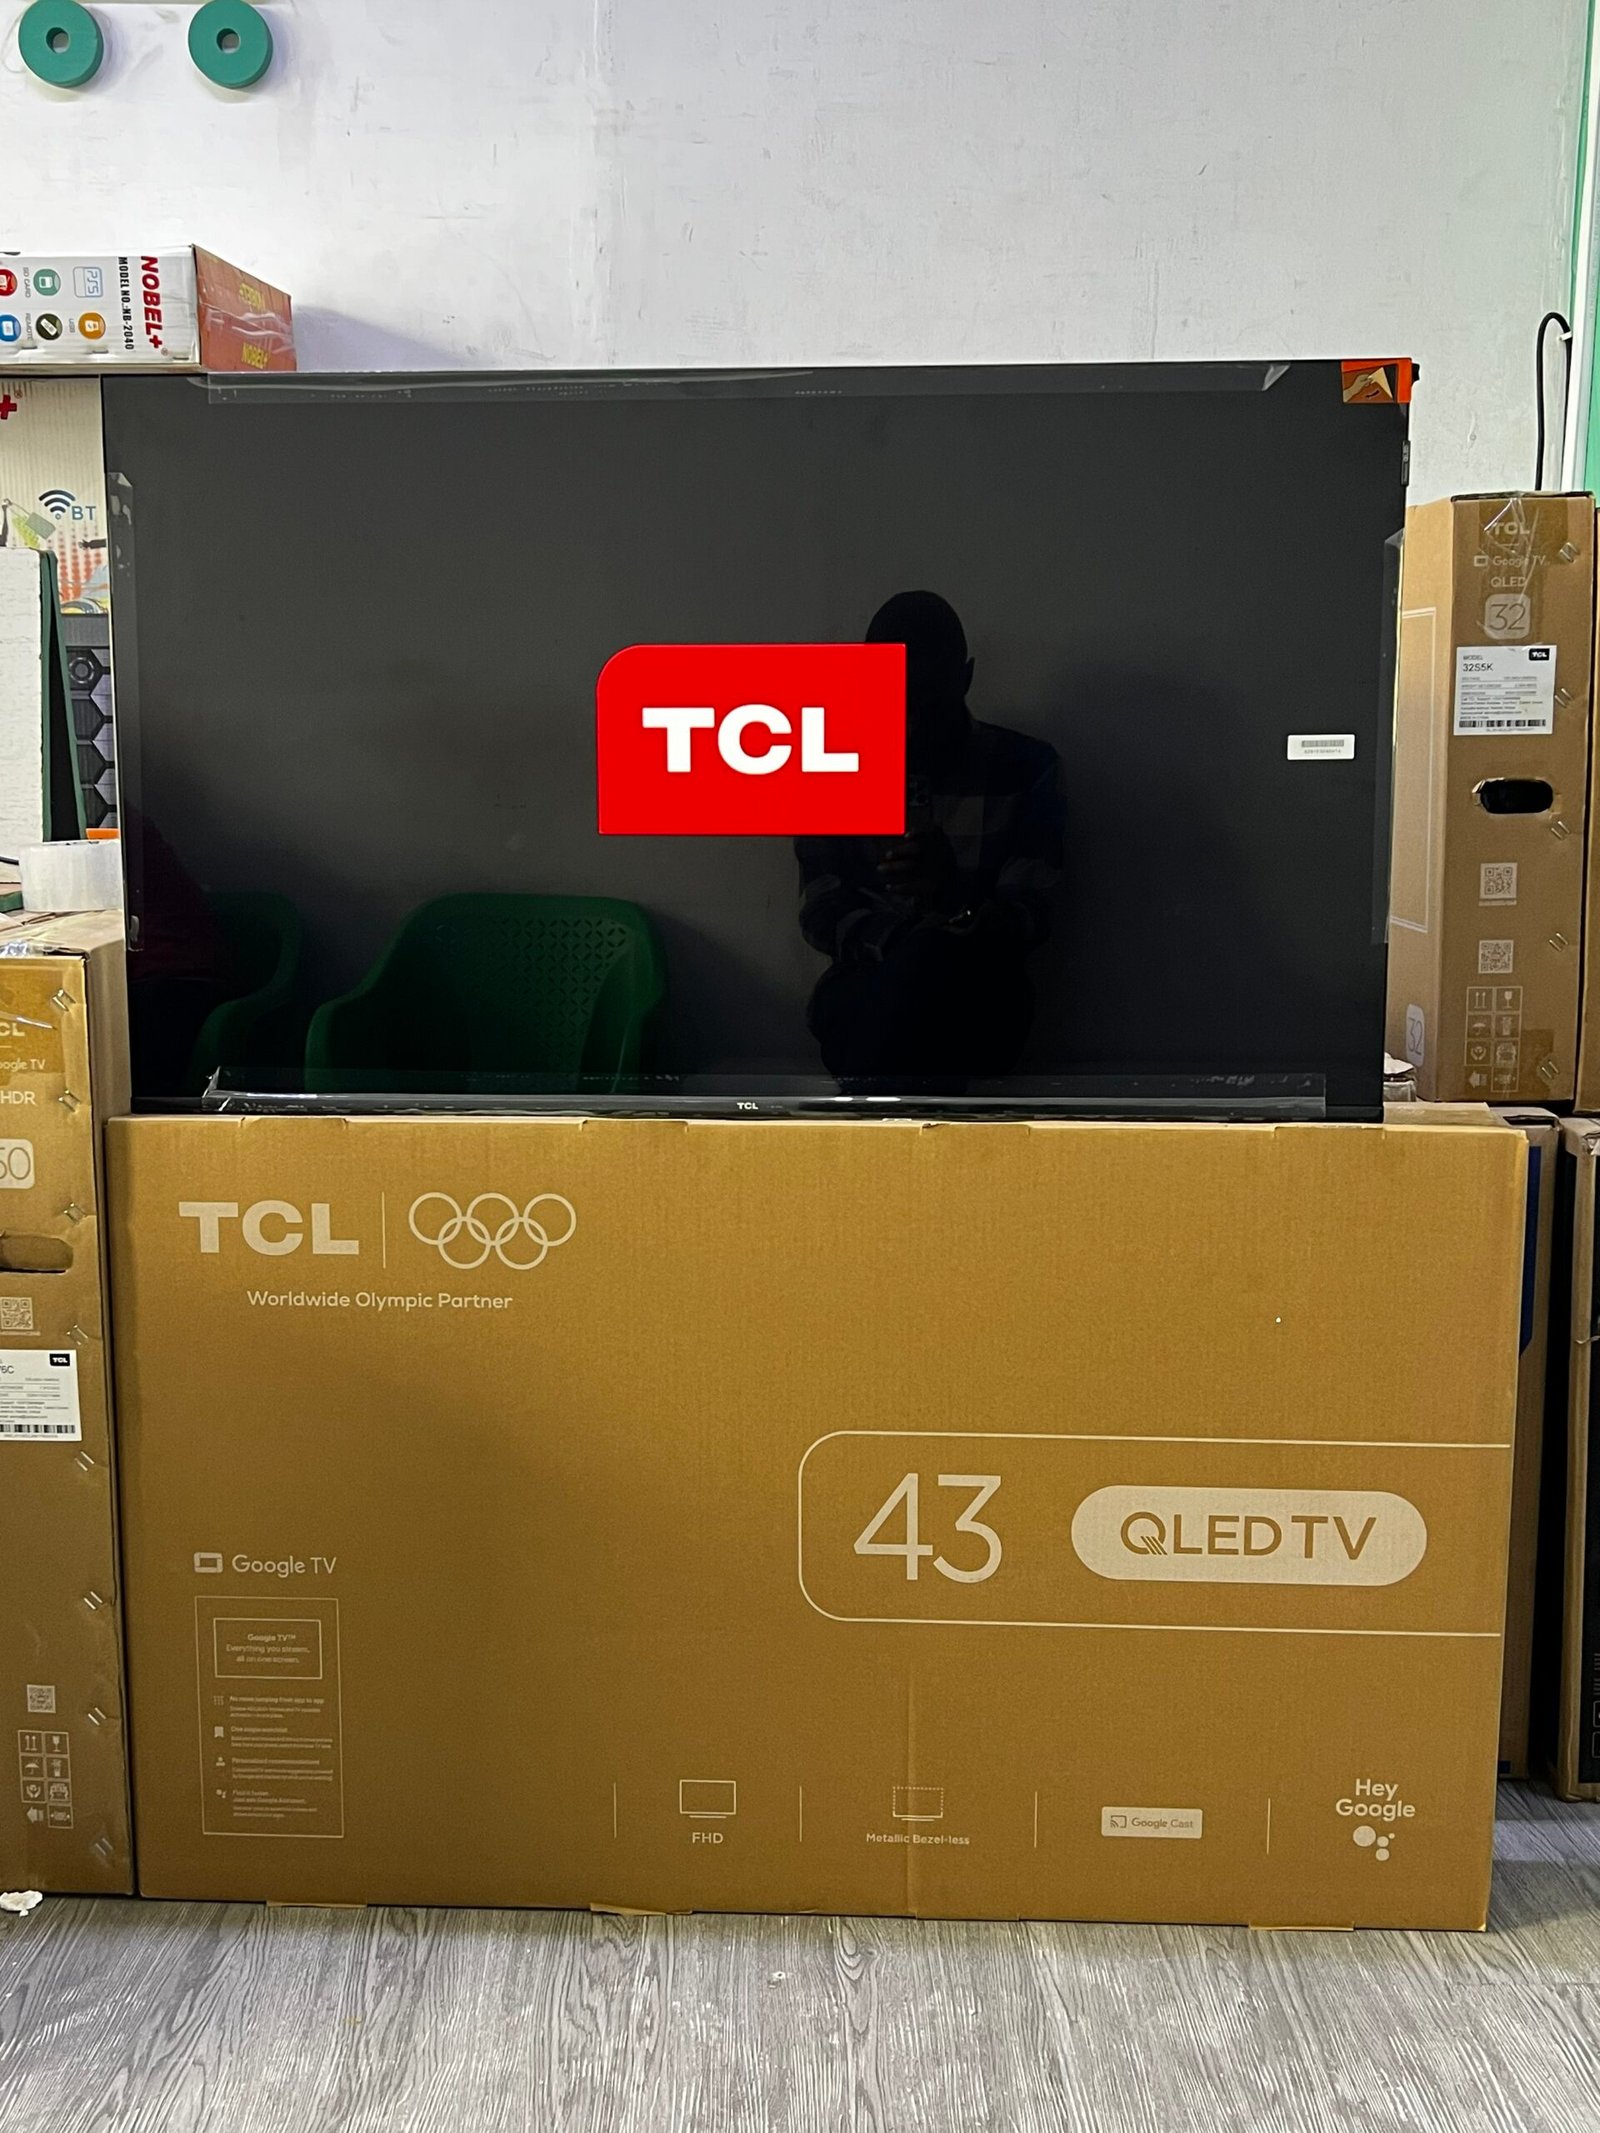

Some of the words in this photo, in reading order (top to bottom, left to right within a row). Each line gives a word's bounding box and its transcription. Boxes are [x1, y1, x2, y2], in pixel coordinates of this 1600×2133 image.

[86, 270, 99, 294] PS5
[118, 257, 130, 288] MODEL
[141, 256, 163, 348] NOBEL+
[71, 506, 96, 520] BT
[1492, 521, 1530, 535] TCL
[1490, 576, 1526, 588] QLED
[1489, 603, 1526, 631] 32
[1462, 663, 1494, 672] 32S5K
[642, 704, 859, 775] TCL
[30, 1059, 46, 1070] TV
[737, 1102, 759, 1110] TCL
[178, 1199, 359, 1256] TCL
[247, 1290, 350, 1308] Worldwide
[355, 1292, 433, 1312] Olympic
[438, 1293, 513, 1309] Partner
[853, 1472, 1002, 1584] 43
[1120, 1511, 1282, 1556] QLED
[1291, 1515, 1377, 1560] TV
[232, 1554, 306, 1578] Google
[310, 1556, 337, 1574] TV
[1355, 1778, 1398, 1801] Hey
[1335, 1799, 1416, 1821] Google
[1131, 1817, 1168, 1829] Google
[1170, 1818, 1193, 1829] Cast
[692, 1832, 724, 1844] FHD
[866, 1833, 909, 1844] Metallic
[912, 1834, 970, 1845] Bezel-less
